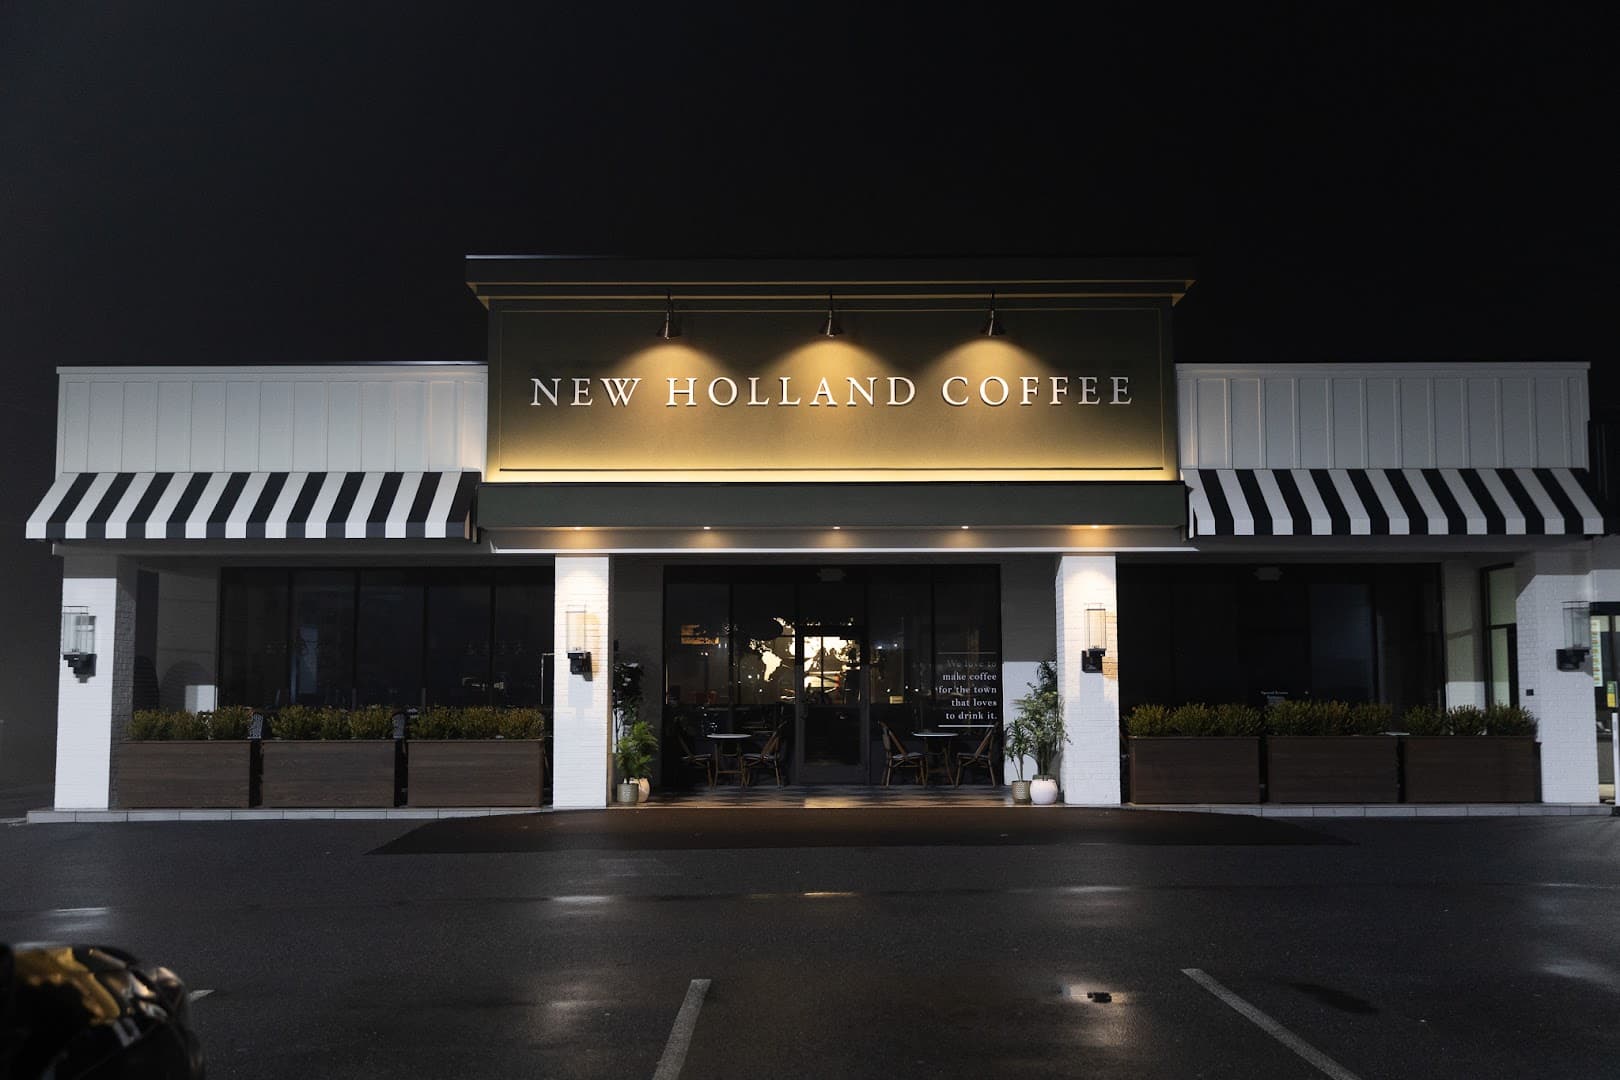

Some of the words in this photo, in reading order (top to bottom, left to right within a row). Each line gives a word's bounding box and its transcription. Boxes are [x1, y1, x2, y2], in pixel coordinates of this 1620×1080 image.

[530, 378, 641, 406] NEW
[665, 376, 915, 406] HOLLAND
[941, 376, 1132, 406] COFFEE
[942, 671, 967, 681] make
[969, 671, 997, 681] coffee
[938, 685, 953, 694] for
[955, 685, 970, 694] the
[973, 686, 997, 694] town
[951, 698, 971, 707] that
[973, 698, 998, 707] loves
[945, 711, 956, 720] to
[957, 711, 984, 720] drink
[987, 711, 998, 720] it.
